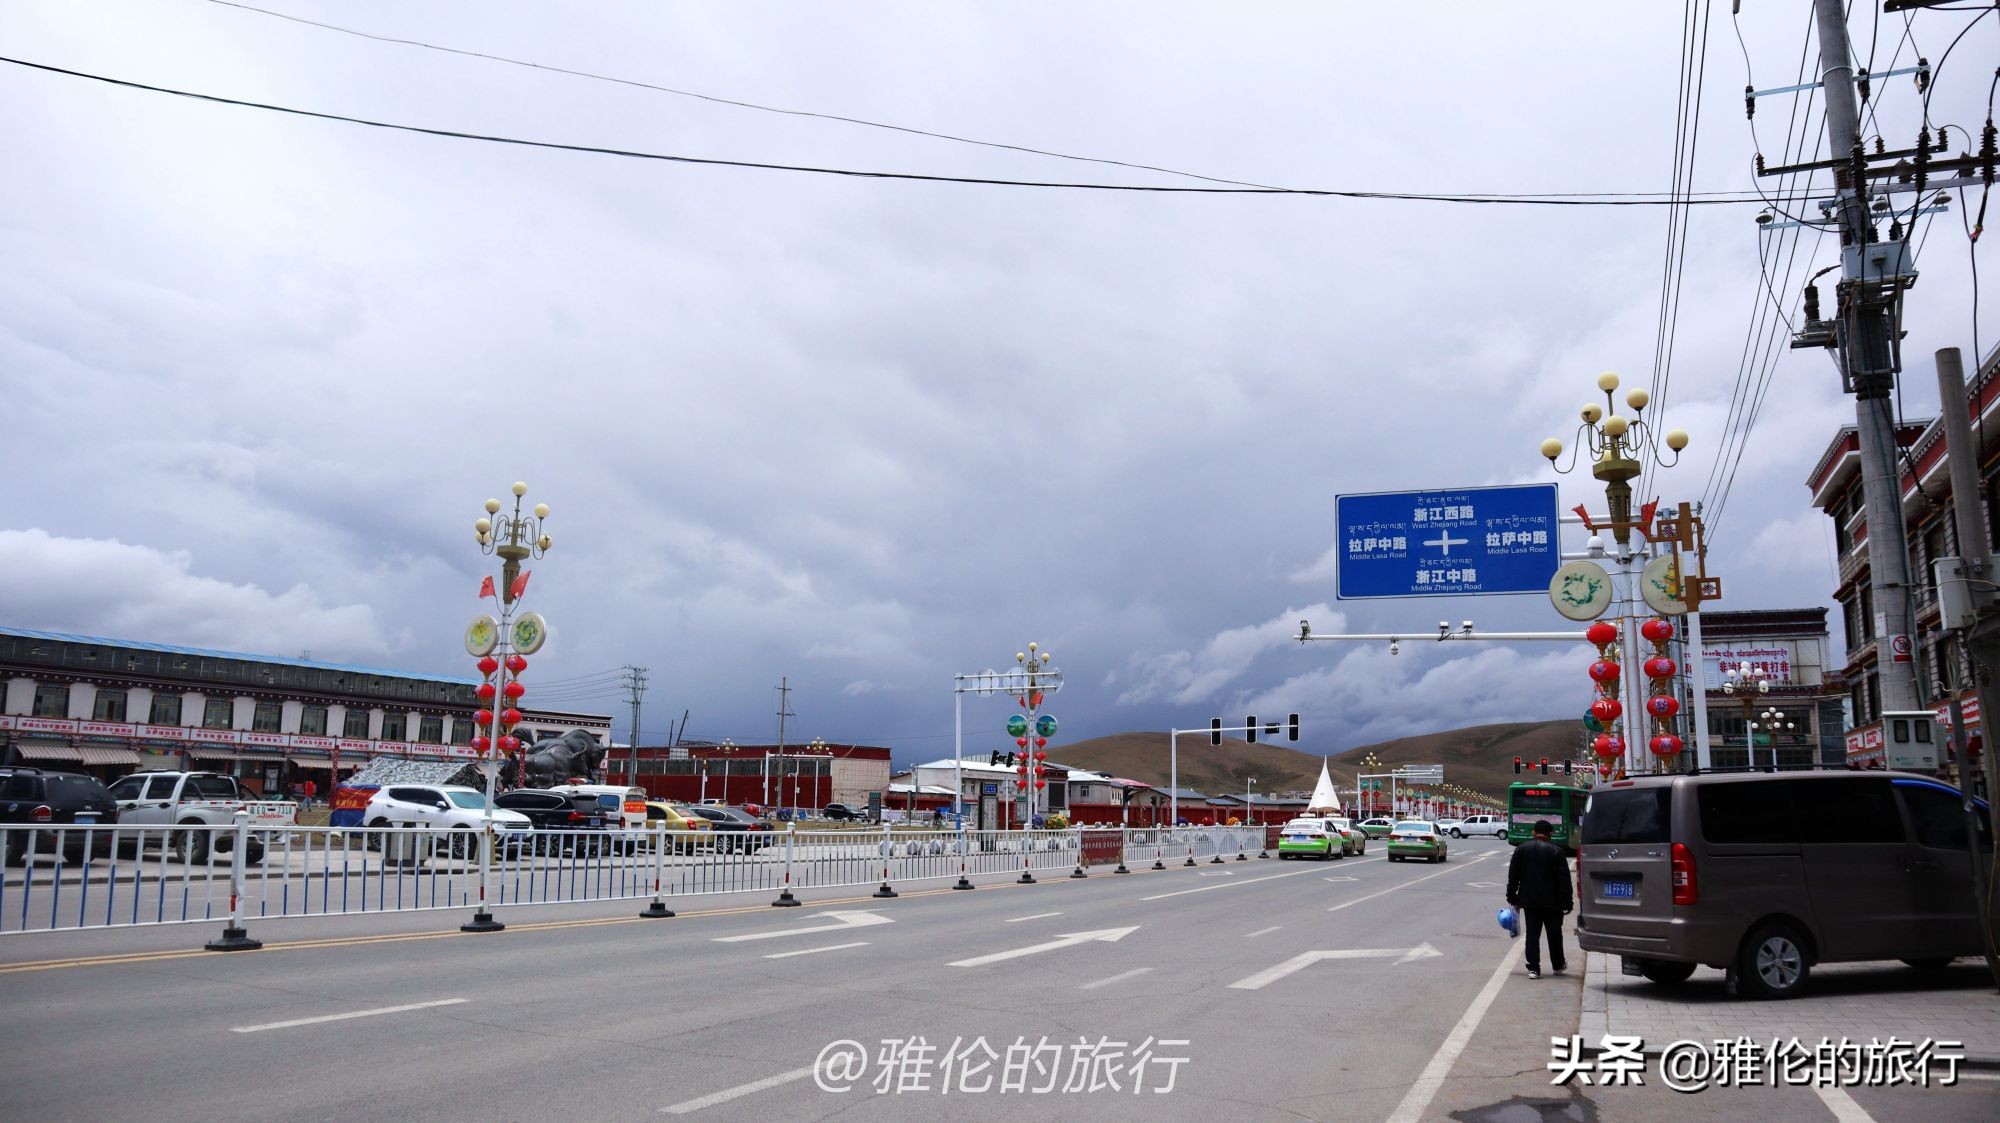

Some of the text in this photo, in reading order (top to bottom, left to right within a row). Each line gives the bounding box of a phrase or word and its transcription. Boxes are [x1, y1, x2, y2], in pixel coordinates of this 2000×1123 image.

[1414, 505, 1474, 522] 浙江西路
[1430, 521, 1458, 529] Zhejiang
[1348, 536, 1407, 553] 拉萨中路
[1486, 530, 1548, 547] 拉萨中路
[1389, 551, 1407, 559] Road
[1416, 568, 1477, 585] 浙江中路
[1434, 584, 1462, 592] Zhejiang
